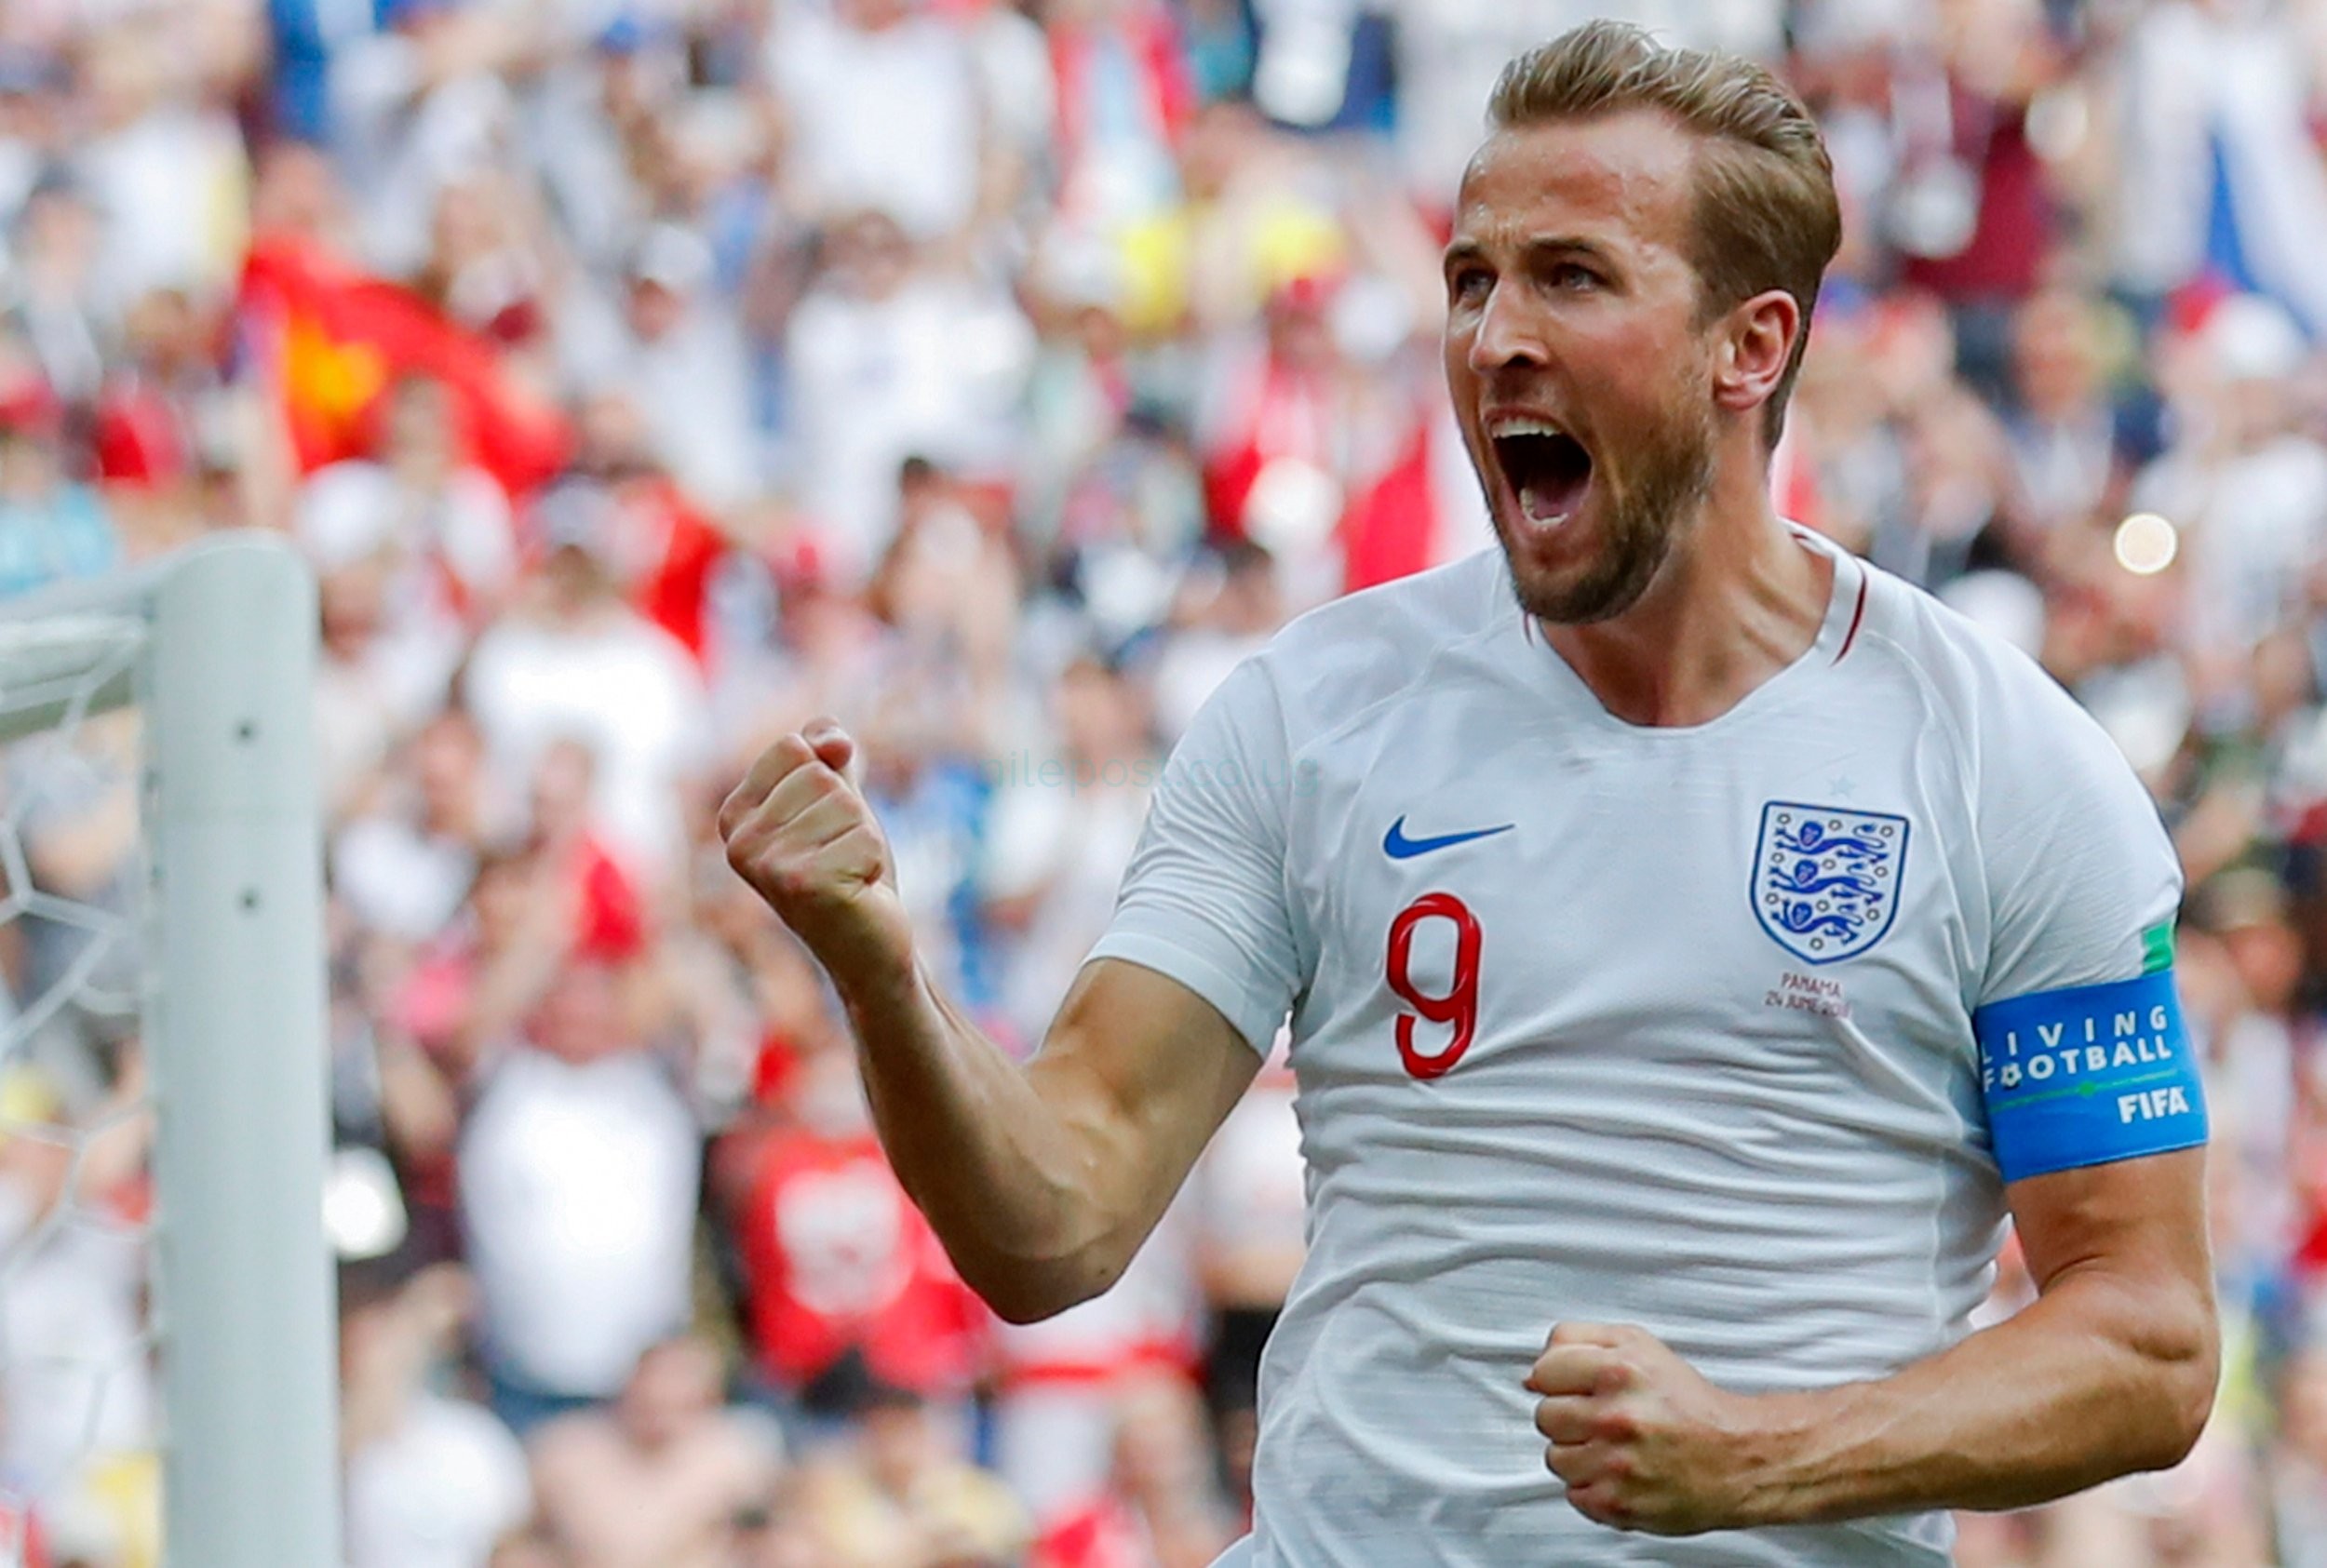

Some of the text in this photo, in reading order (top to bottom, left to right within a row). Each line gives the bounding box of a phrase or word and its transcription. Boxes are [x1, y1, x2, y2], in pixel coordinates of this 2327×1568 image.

[1386, 891, 1483, 1080] 9
[1781, 972, 1841, 998] PANAMA
[2118, 1086, 2189, 1124] FIFA
